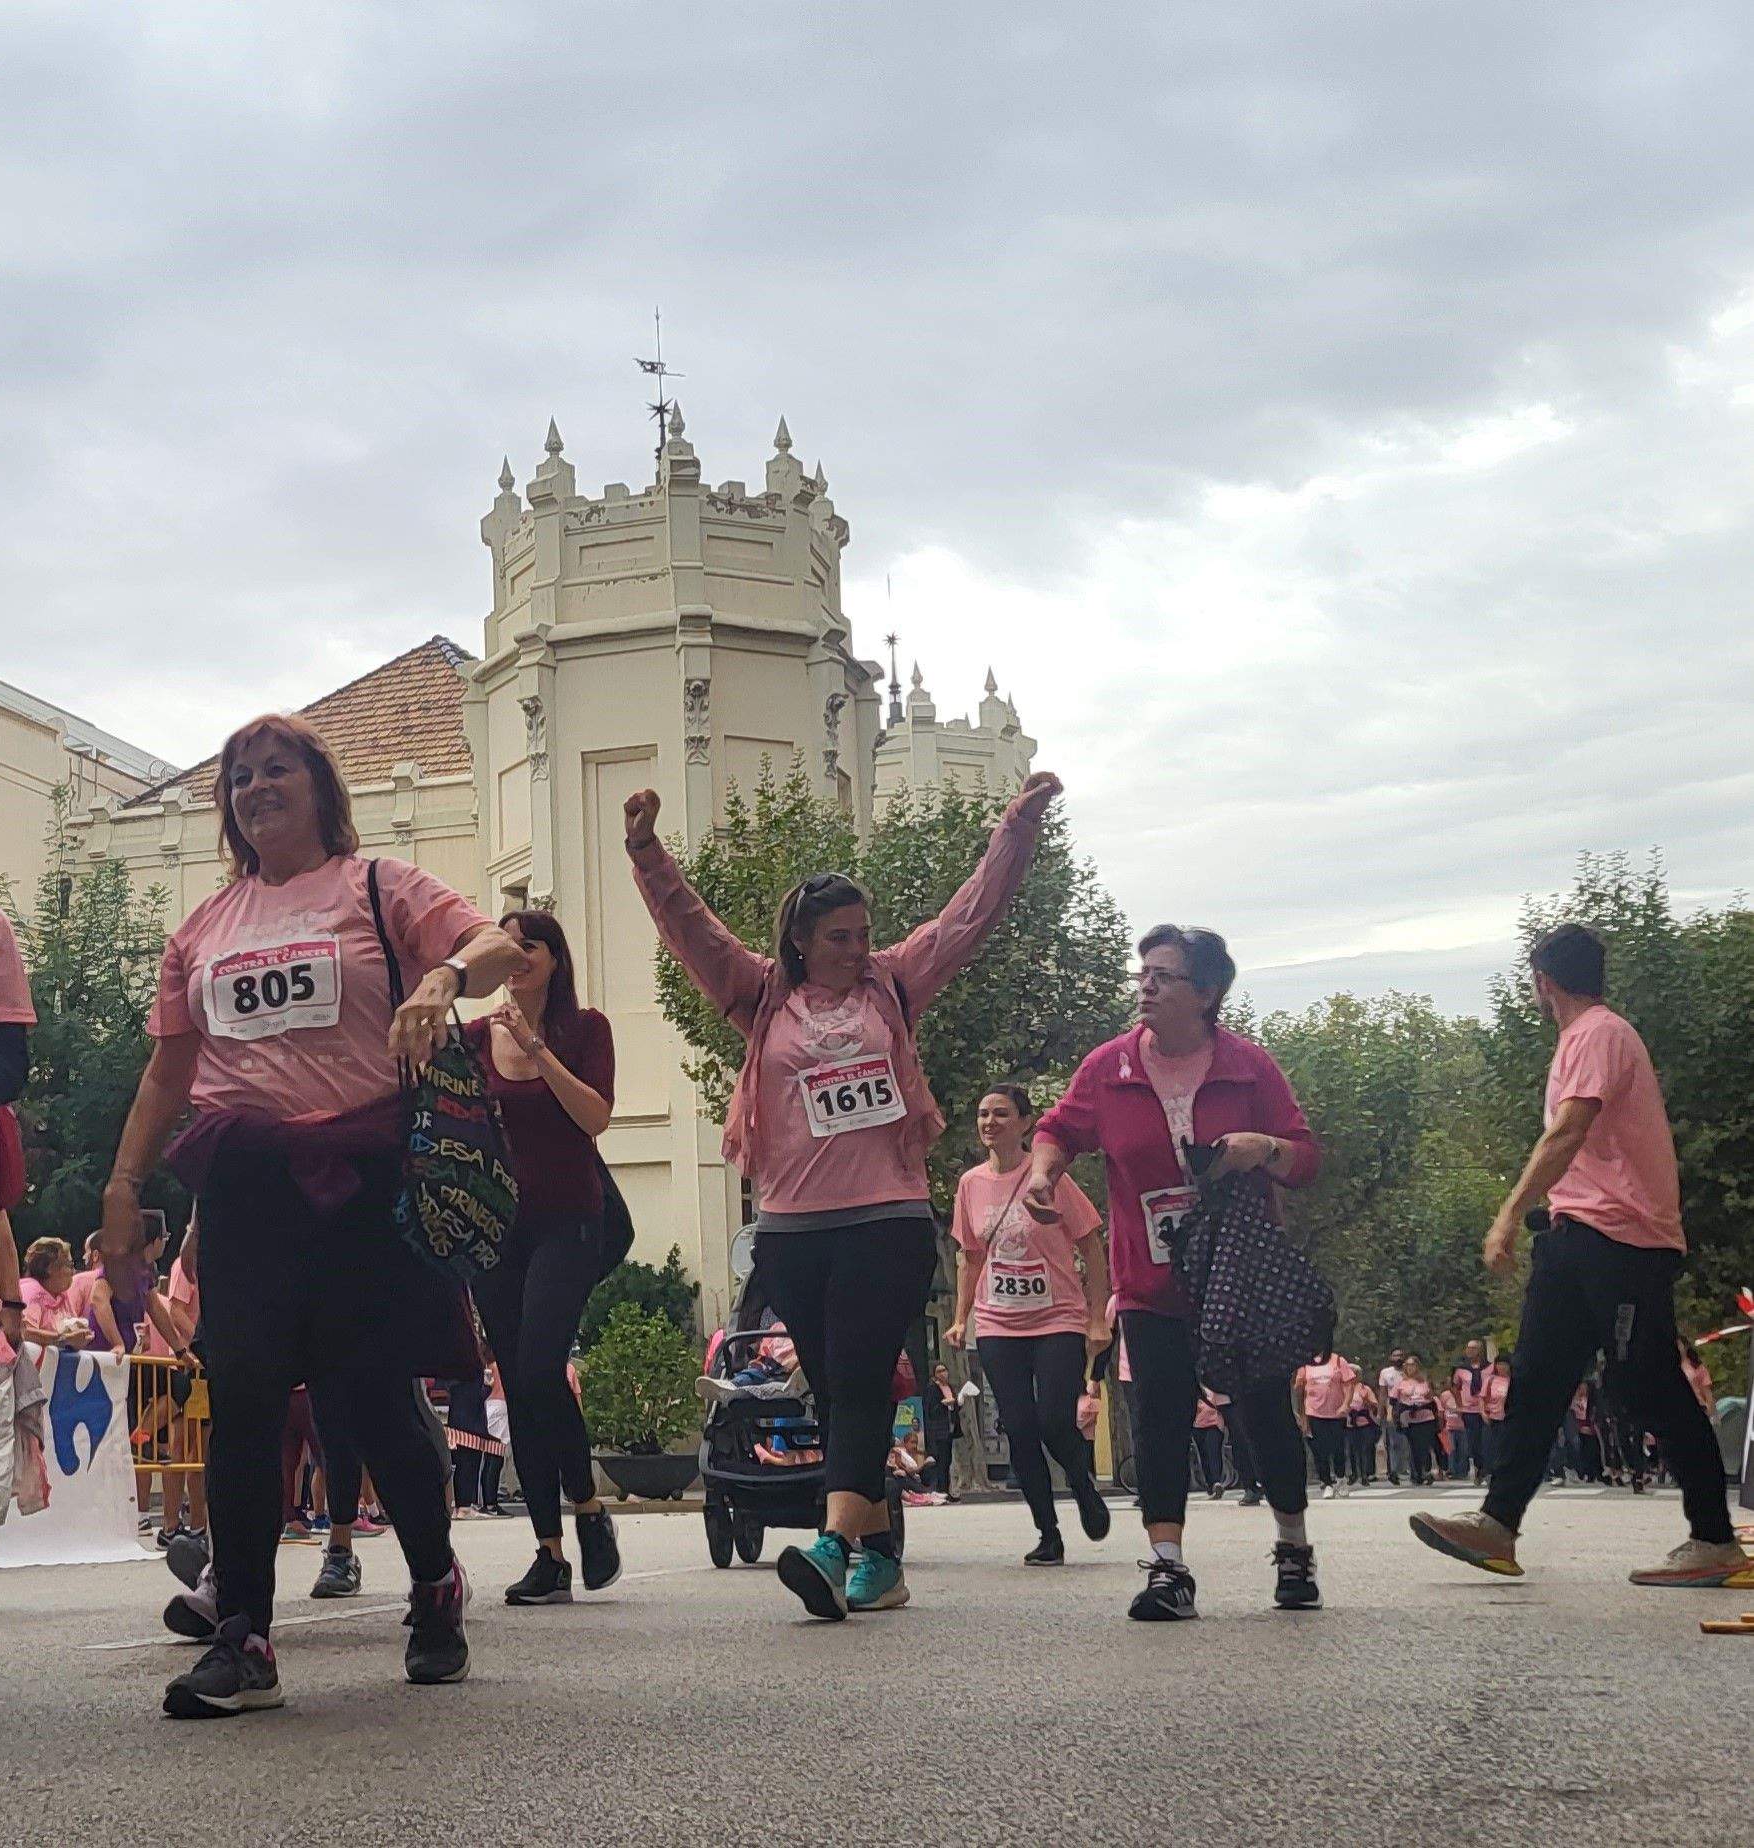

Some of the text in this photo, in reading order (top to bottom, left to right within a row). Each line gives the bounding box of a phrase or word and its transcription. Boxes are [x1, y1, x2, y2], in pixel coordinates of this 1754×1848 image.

[233, 963, 315, 1014] 805
[815, 1078, 893, 1117] 1615
[994, 1275, 1046, 1296] 2830
